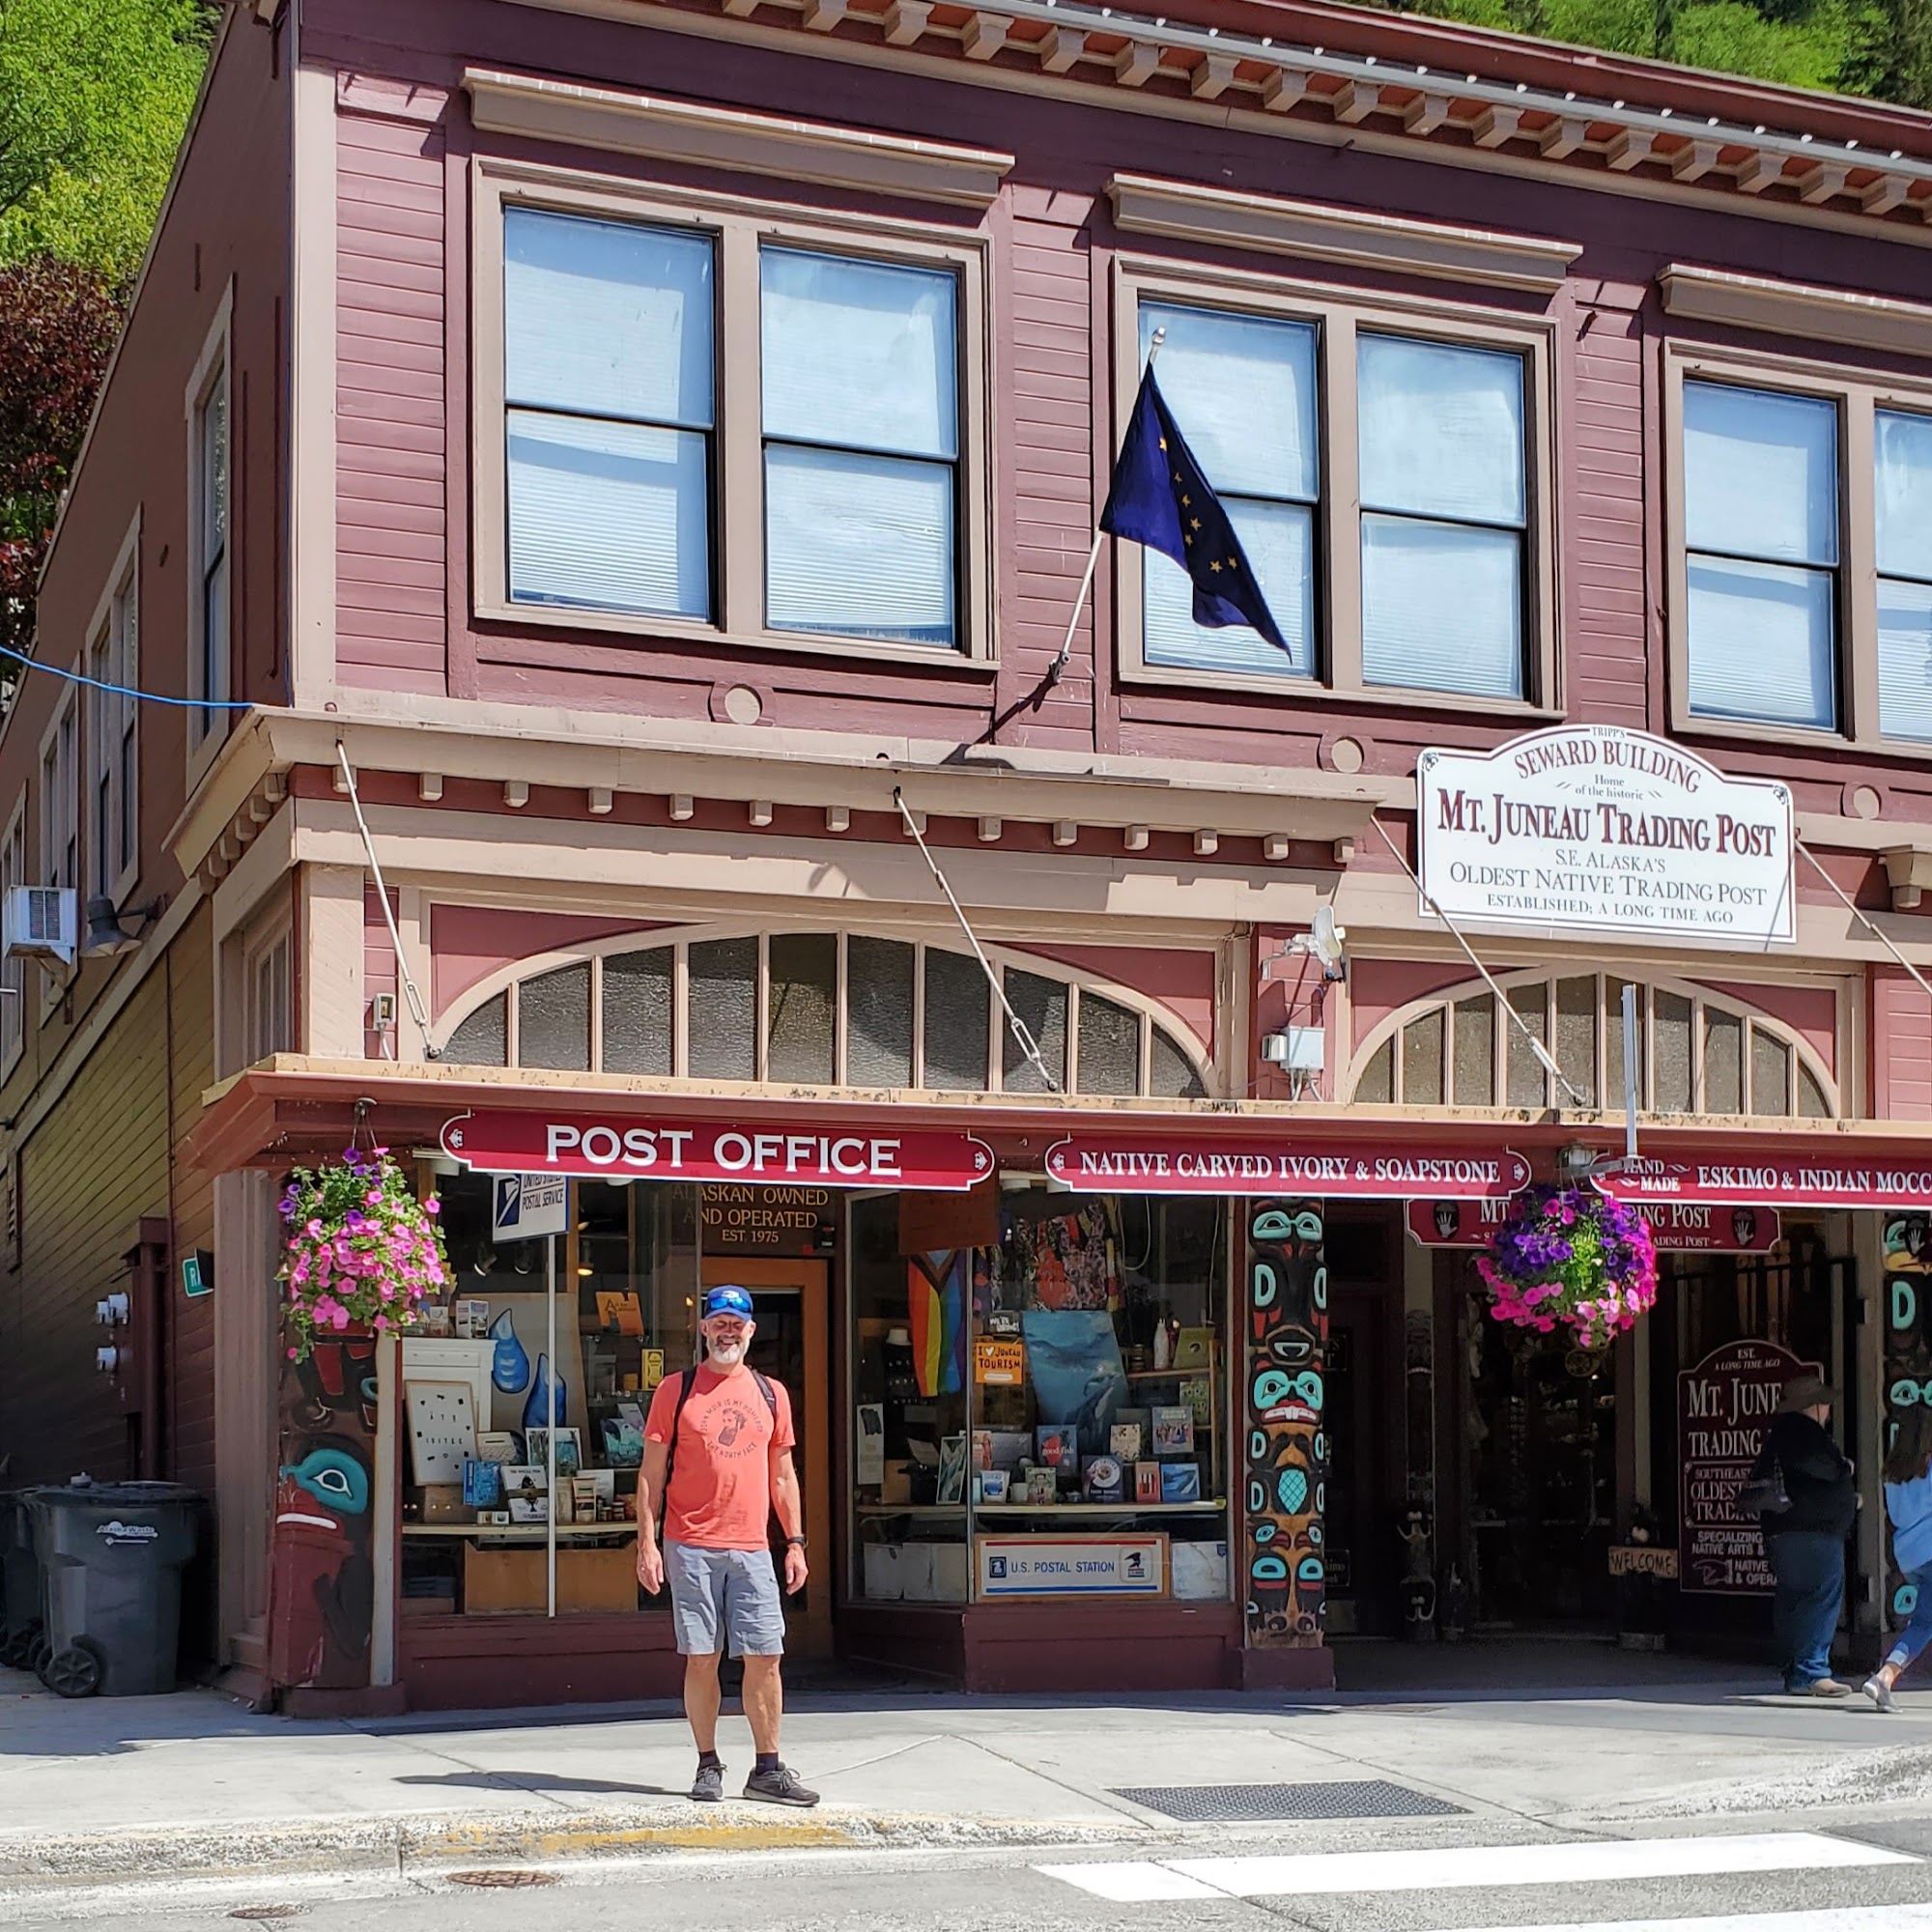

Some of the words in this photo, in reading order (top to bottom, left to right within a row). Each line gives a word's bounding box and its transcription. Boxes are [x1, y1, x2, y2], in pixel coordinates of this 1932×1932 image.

[1592, 726, 1626, 738] TRIPP'S
[1515, 739, 1597, 780] SEWARD
[1603, 739, 1701, 793] BUILDING
[1595, 774, 1625, 787] Home
[1575, 786, 1586, 795] of
[1588, 785, 1604, 797] the
[1606, 787, 1644, 800] historic
[1437, 788, 1487, 834] MT.
[1489, 793, 1591, 845] JUNEAU
[1597, 803, 1711, 851] TRADING
[1716, 813, 1776, 857] POST
[1555, 848, 1581, 867] S.E.
[1586, 851, 1665, 873] ALASKA'S
[1450, 861, 1530, 888] OLDEST
[1535, 868, 1614, 895] NATIVE
[1620, 875, 1713, 902] TRADING
[1719, 883, 1767, 905] POST
[1599, 902, 1607, 915] A
[1614, 903, 1654, 918] LONG
[1661, 906, 1698, 922] TIME
[1703, 910, 1733, 923] AGO
[545, 1124, 694, 1168] POST
[713, 1132, 902, 1178] OFFICE
[1080, 1151, 1171, 1176] NATIVE
[1177, 1153, 1273, 1179] CARVED
[1279, 1156, 1350, 1179] IVORY
[1354, 1162, 1370, 1179] &
[1375, 1159, 1500, 1182] SOAPSTONE
[1640, 1176, 1681, 1191] MADE
[1697, 1166, 1777, 1190] ESKIMO
[1781, 1171, 1795, 1190] &
[1799, 1169, 1870, 1192] INDIAN
[523, 1193, 541, 1210] POSTAL
[542, 1188, 564, 1207] SERVICE
[763, 1187, 829, 1206] OWNED
[727, 1208, 818, 1229] OPERATED
[1671, 1204, 1711, 1229] POST
[752, 1230, 780, 1243] 1975
[1685, 1236, 1710, 1247] POST
[995, 1347, 1021, 1357] JUNEAU
[1738, 1349, 1756, 1360] EST.
[979, 1357, 1021, 1370] TOURISM
[1721, 1360, 1741, 1371] LONG
[1744, 1359, 1763, 1370] TIME
[1765, 1358, 1780, 1368] AGO
[1688, 1378, 1723, 1417] MT.
[1727, 1378, 1782, 1426] JUNE
[719, 1450, 742, 1460] NORTH
[743, 1440, 757, 1457] FACE
[1041, 1446, 1060, 1457] good
[1688, 1429, 1763, 1457] TRADING
[1697, 1531, 1764, 1545] SPECIALIZING
[1692, 1543, 1724, 1554] NATIVE
[1728, 1543, 1754, 1556] ARTS
[1011, 1561, 1030, 1573] U.S.
[1035, 1561, 1071, 1573] POSTAL
[1076, 1560, 1115, 1573] STATION
[1609, 1551, 1672, 1576] WELCOME
[1735, 1560, 1769, 1573] NATIVE
[1747, 1573, 1777, 1586] OPERA
